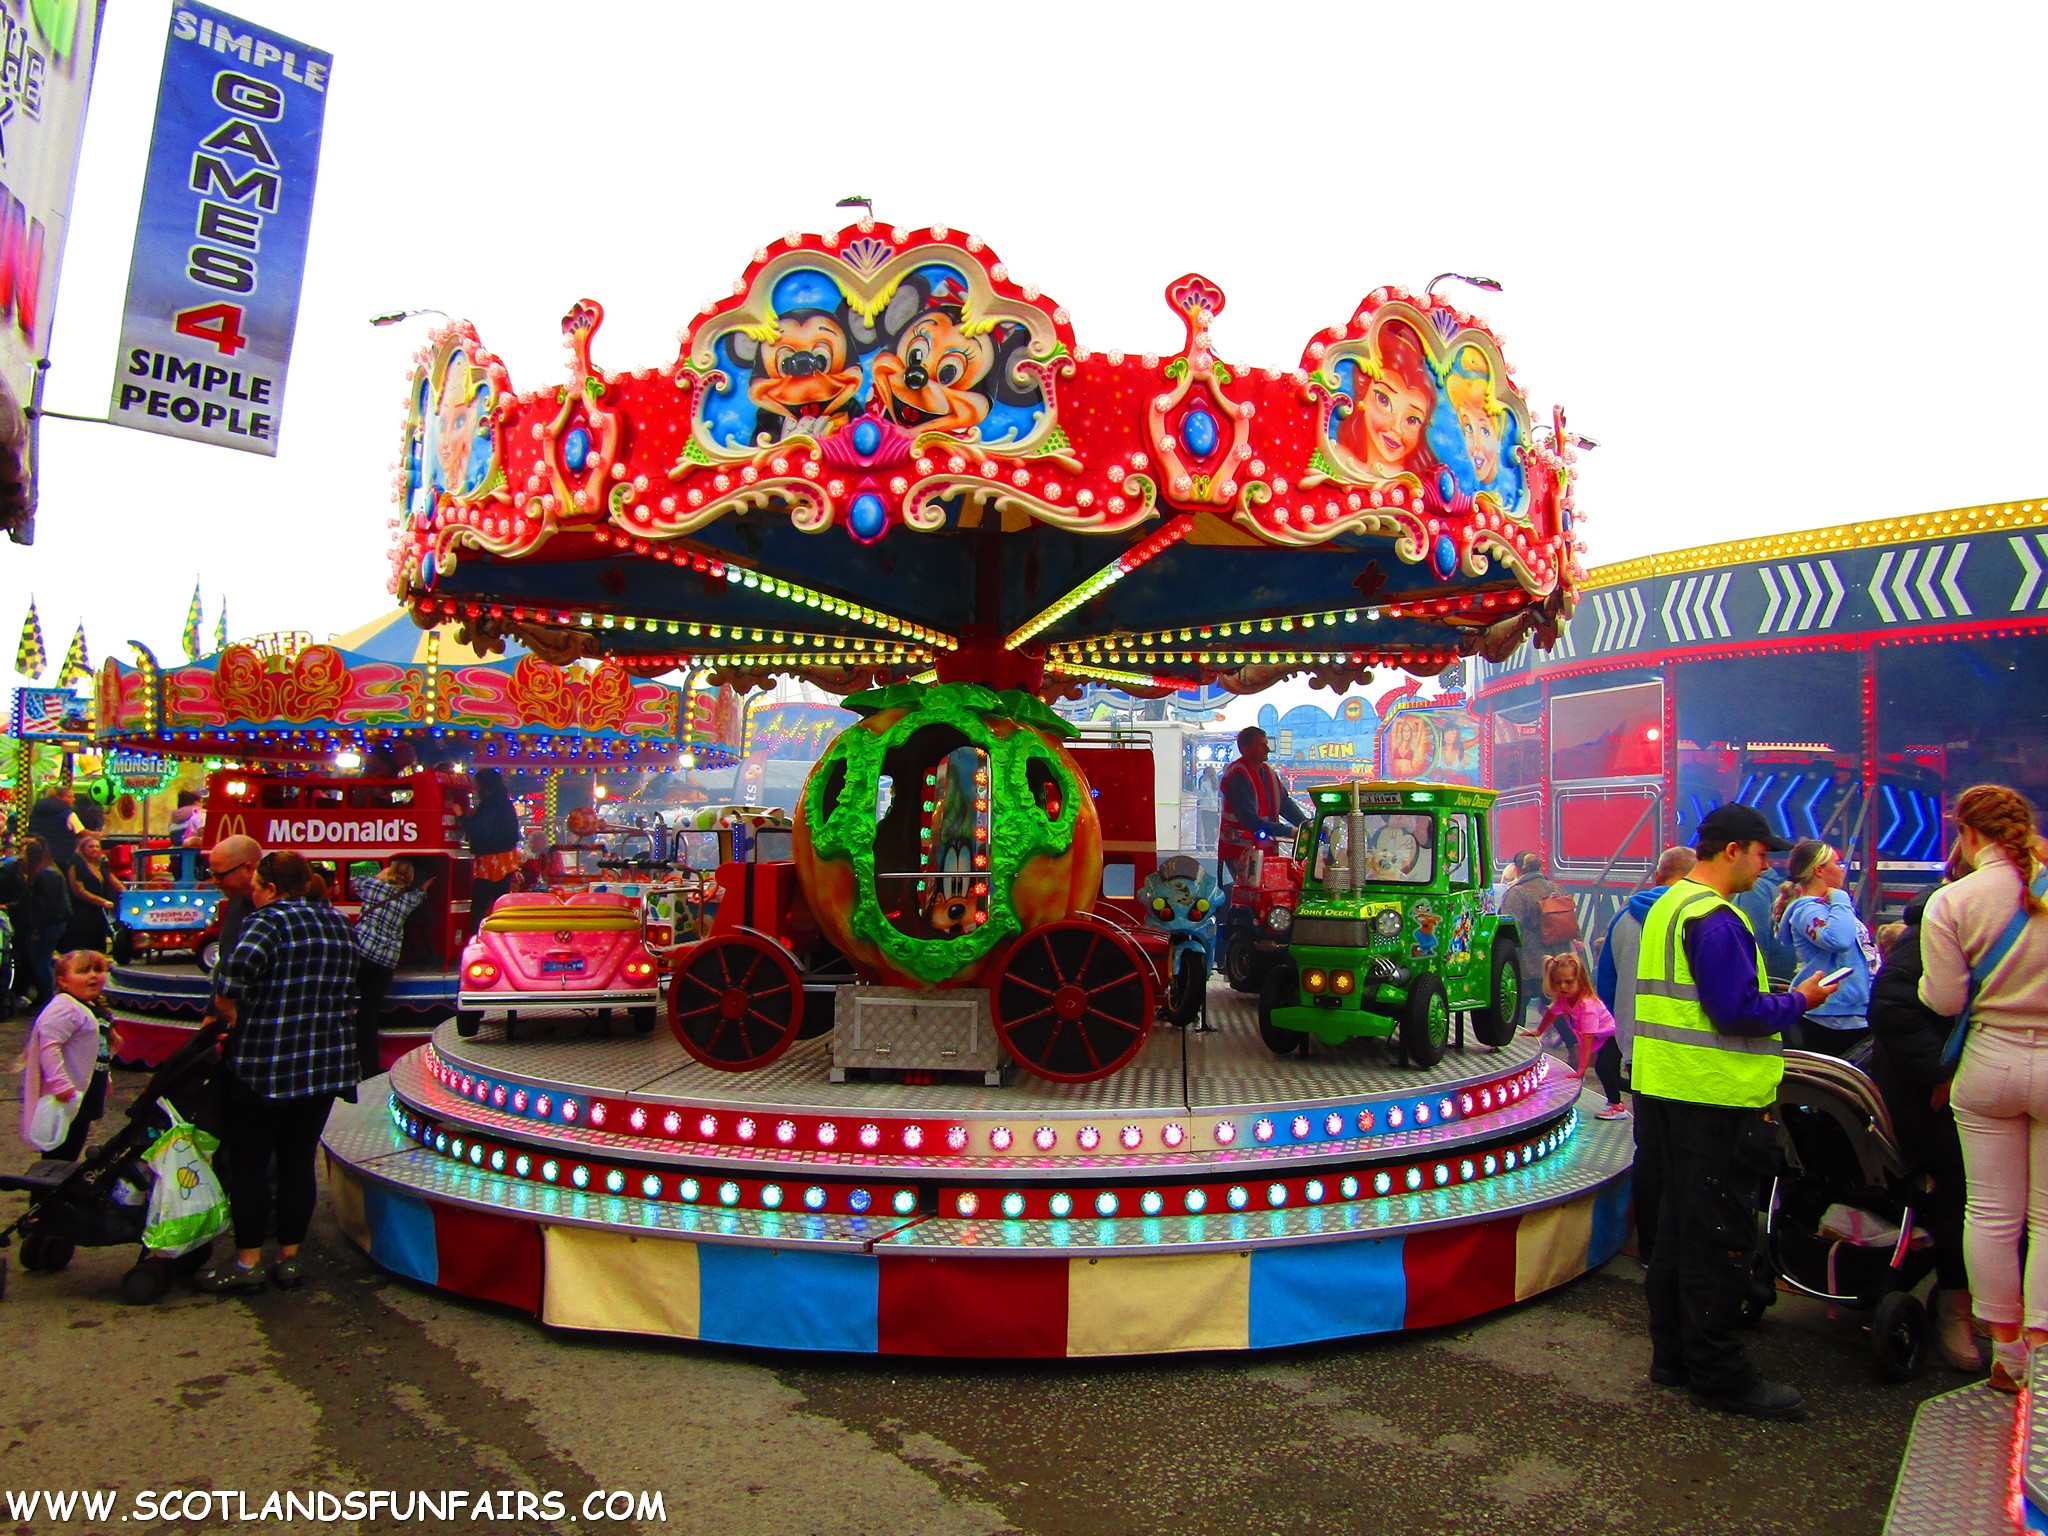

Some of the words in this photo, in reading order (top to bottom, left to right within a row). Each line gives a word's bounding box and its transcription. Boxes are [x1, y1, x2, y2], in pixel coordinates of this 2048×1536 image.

[173, 10, 328, 92] SIMPLE
[189, 70, 284, 295] GAMES
[174, 302, 246, 356] 4
[127, 348, 270, 405] SIMPLE
[118, 384, 270, 440] PEOPLE
[113, 758, 172, 773] MONSTER
[1318, 741, 1355, 760] FUN
[267, 819, 418, 842] McDonald's
[1298, 908, 1323, 916] JOHN
[1325, 909, 1355, 917] DEERE
